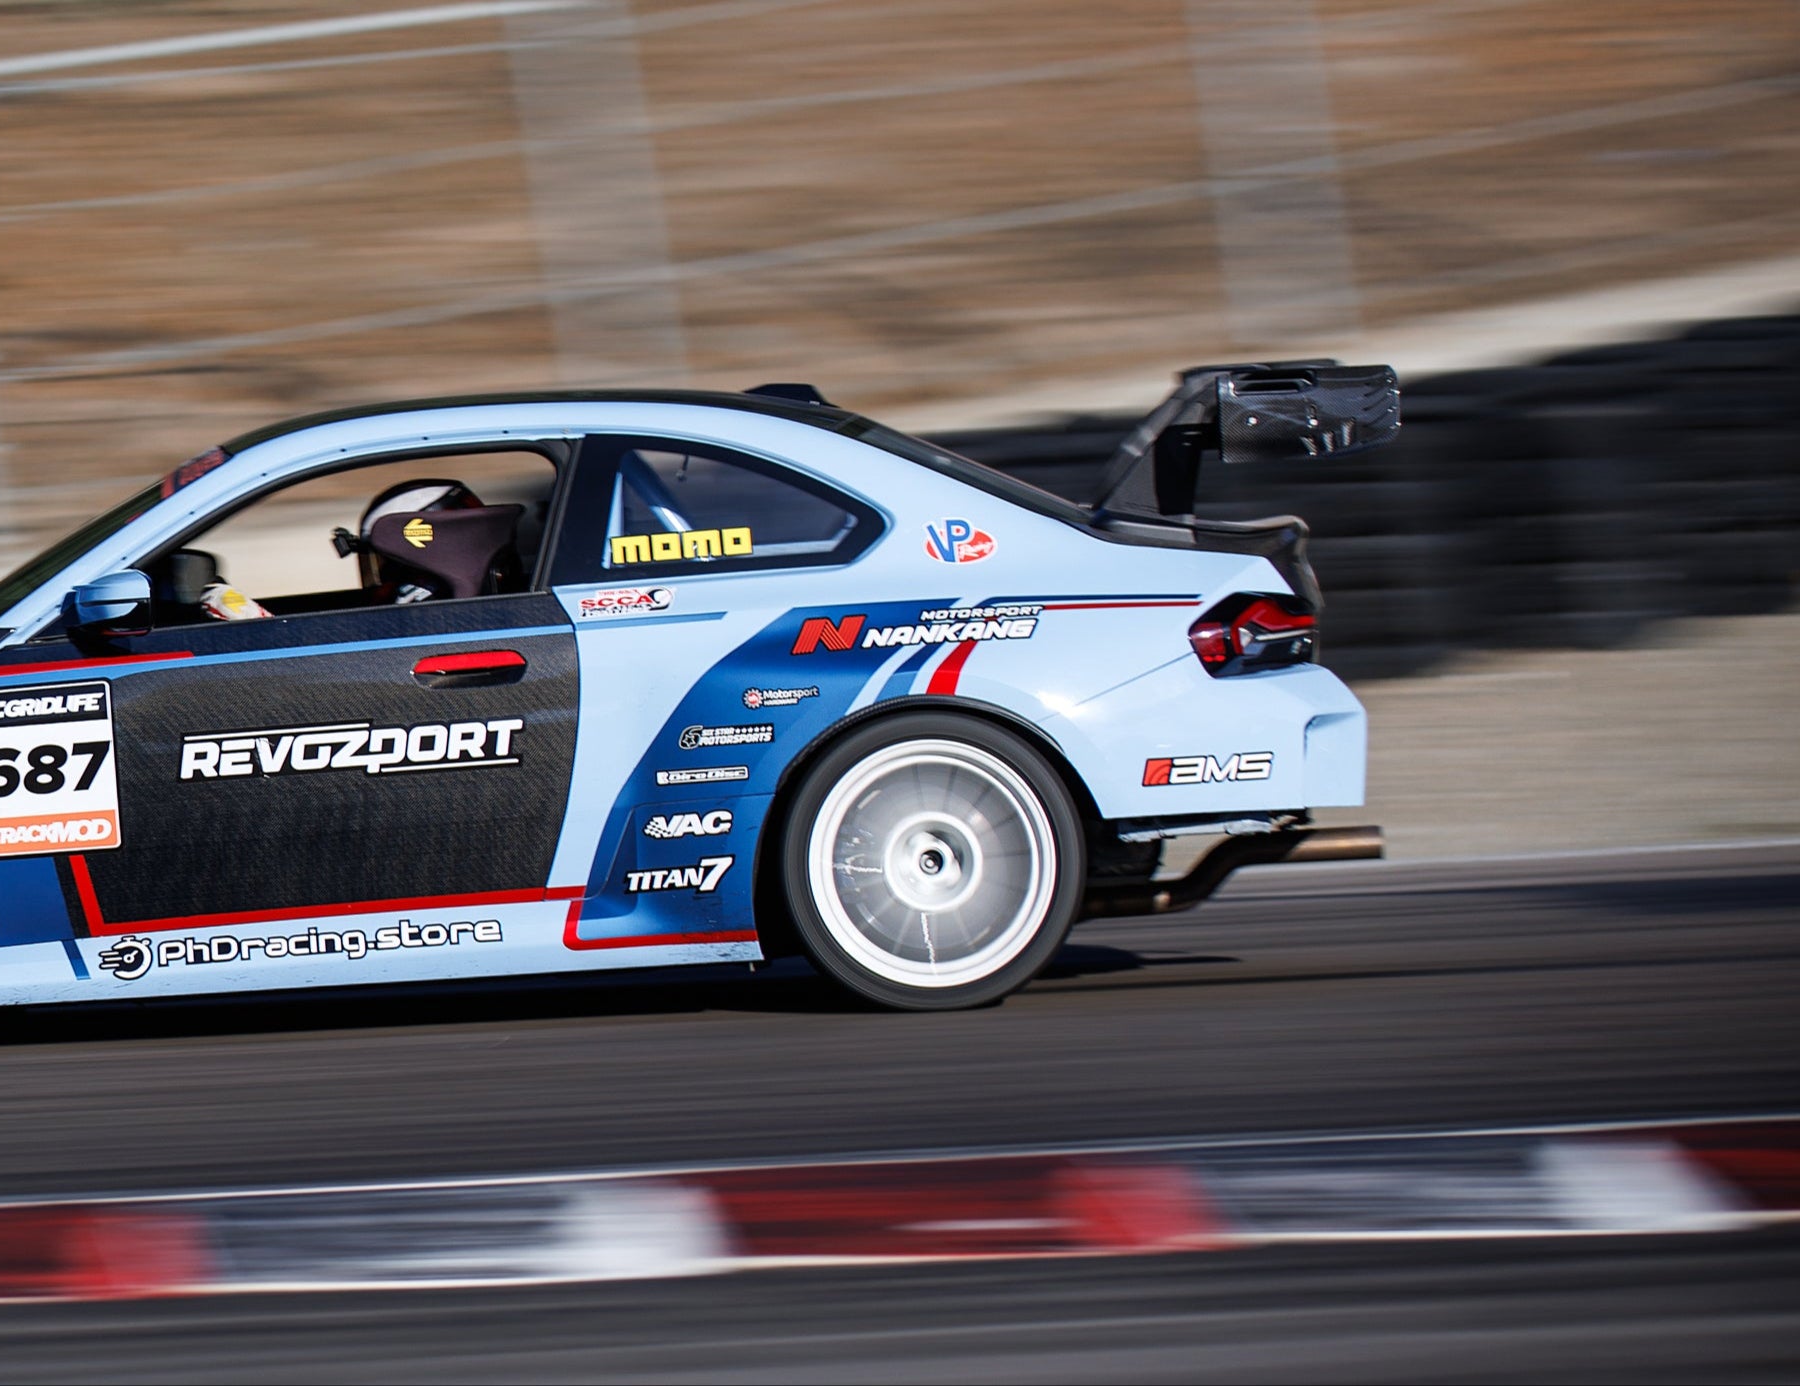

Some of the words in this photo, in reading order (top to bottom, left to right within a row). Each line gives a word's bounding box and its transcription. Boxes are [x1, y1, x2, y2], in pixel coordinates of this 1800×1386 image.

[926, 519, 970, 562] VP
[581, 595, 653, 609] SCCA
[920, 605, 1043, 621] MOTORSPORT
[861, 618, 1038, 648] NANKANG
[3, 692, 105, 718] GRIDLIFE
[763, 687, 819, 699] Motorsport
[699, 732, 773, 746] MOTORSPORTS
[644, 811, 733, 838] VAC
[158, 920, 503, 967] PhDracing.store
